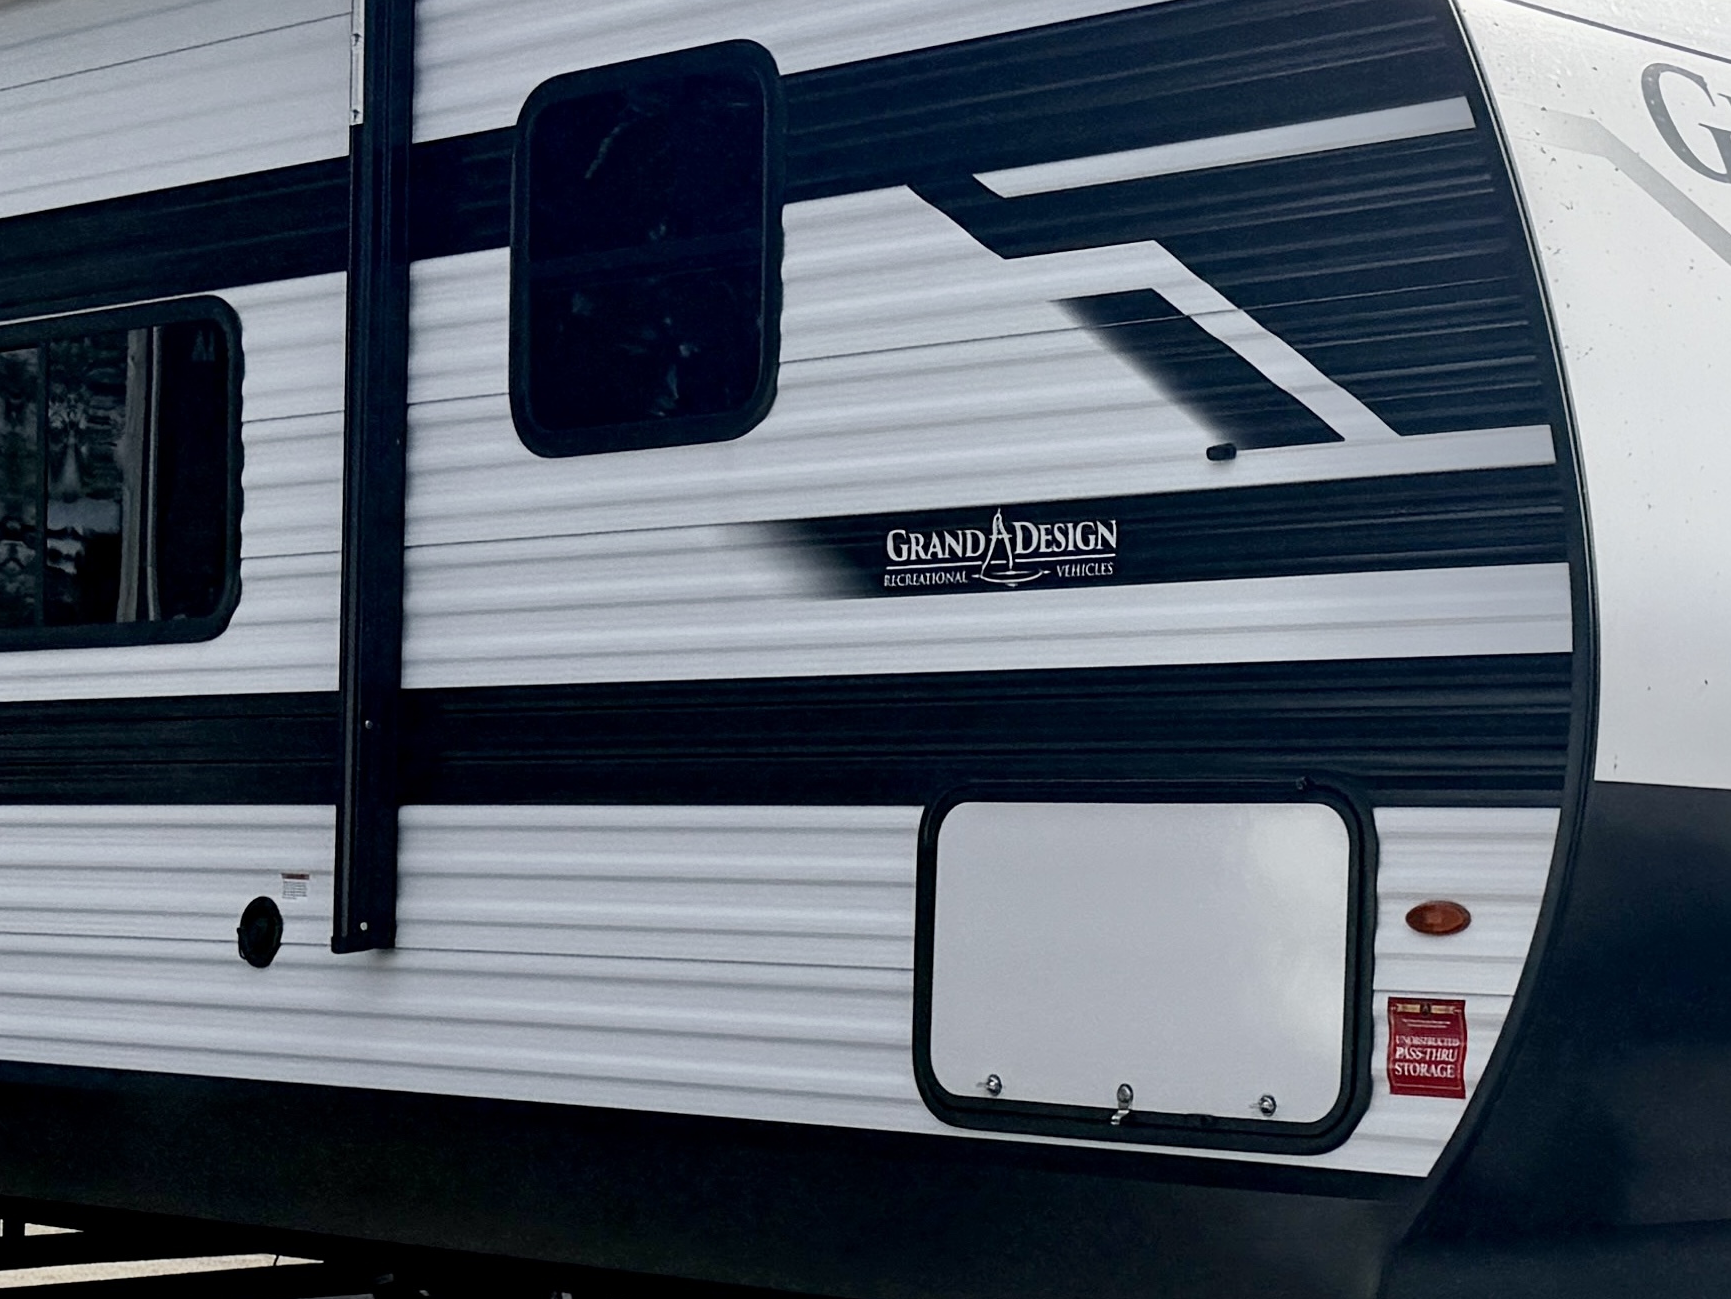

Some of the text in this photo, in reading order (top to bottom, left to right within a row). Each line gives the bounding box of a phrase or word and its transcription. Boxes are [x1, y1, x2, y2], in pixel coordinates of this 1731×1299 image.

[886, 520, 1117, 562] GRAND DESIGN
[884, 562, 1114, 587] RECREATIONAL VEHICLES
[1394, 1062, 1456, 1078] STORAGE
